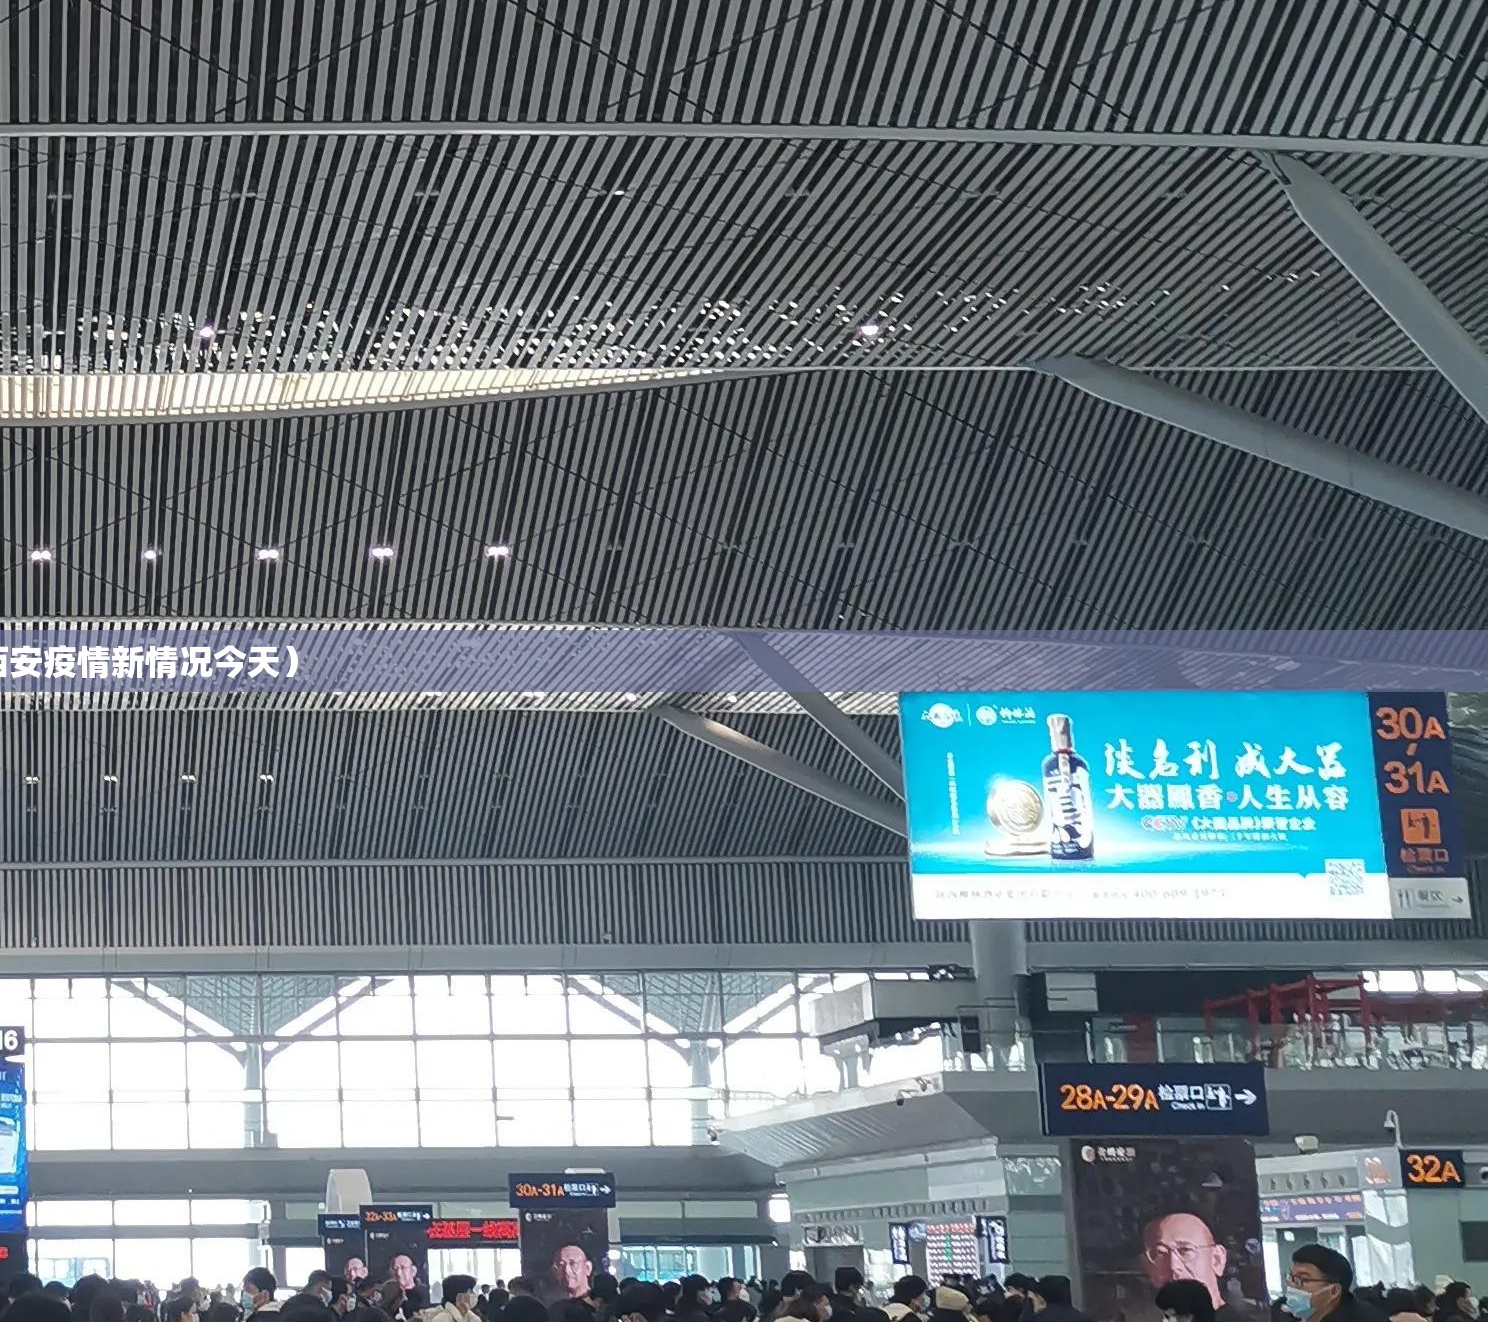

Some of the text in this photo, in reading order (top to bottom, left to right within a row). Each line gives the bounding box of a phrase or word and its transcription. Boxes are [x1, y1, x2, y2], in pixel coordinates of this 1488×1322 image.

[1376, 707, 1446, 740] 30A
[1384, 761, 1450, 794] 31A
[1059, 1083, 1160, 1111] 28A-29A
[1407, 1154, 1460, 1184] 32A
[515, 1183, 565, 1196] 30A-31A
